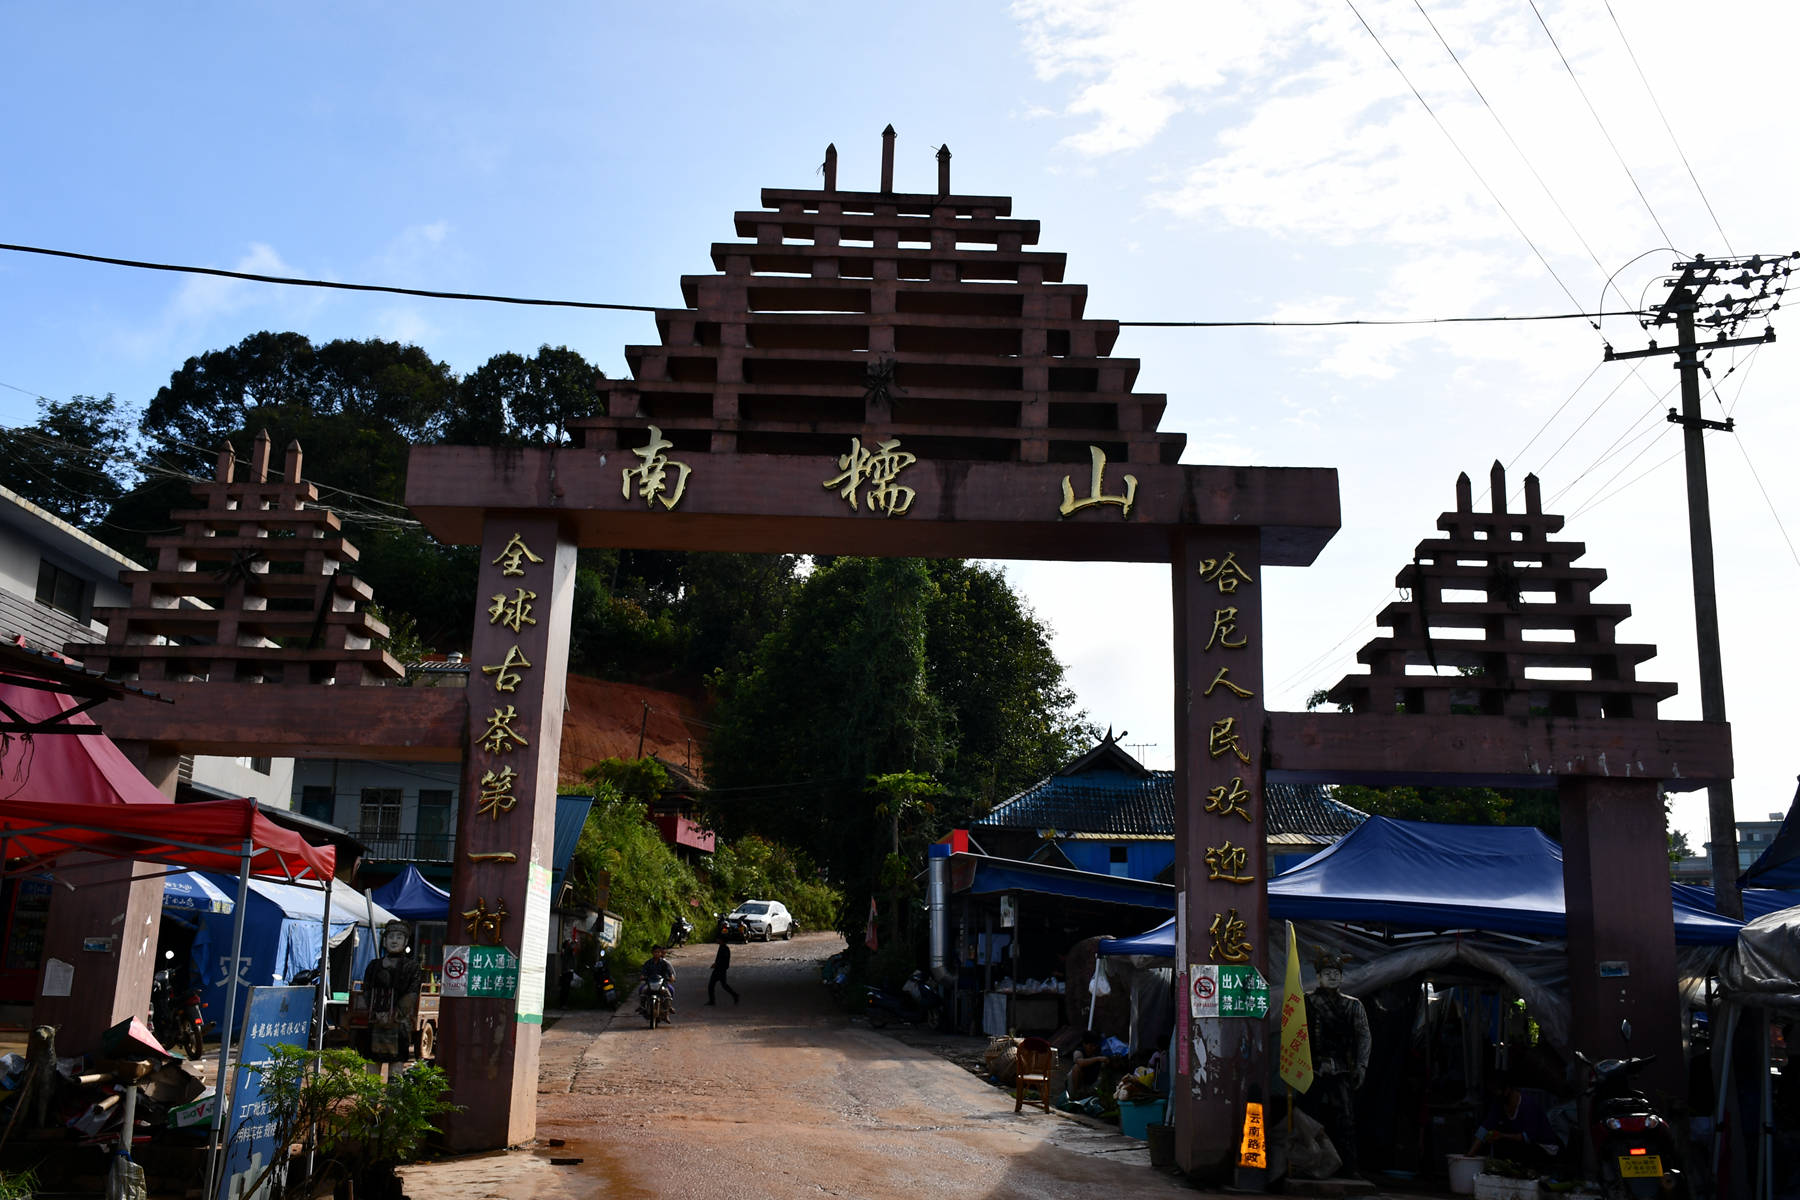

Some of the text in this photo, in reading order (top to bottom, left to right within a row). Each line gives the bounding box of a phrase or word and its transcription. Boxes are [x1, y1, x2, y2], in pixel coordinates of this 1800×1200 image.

[621, 424, 1138, 518] 南糯山
[461, 532, 544, 945] 全球古茶第一村
[1198, 552, 1255, 962] 哈尼人民欢迎您
[471, 975, 516, 991] 禁止停车
[472, 953, 517, 969] 出入通道
[1222, 995, 1269, 1012] 禁止停车
